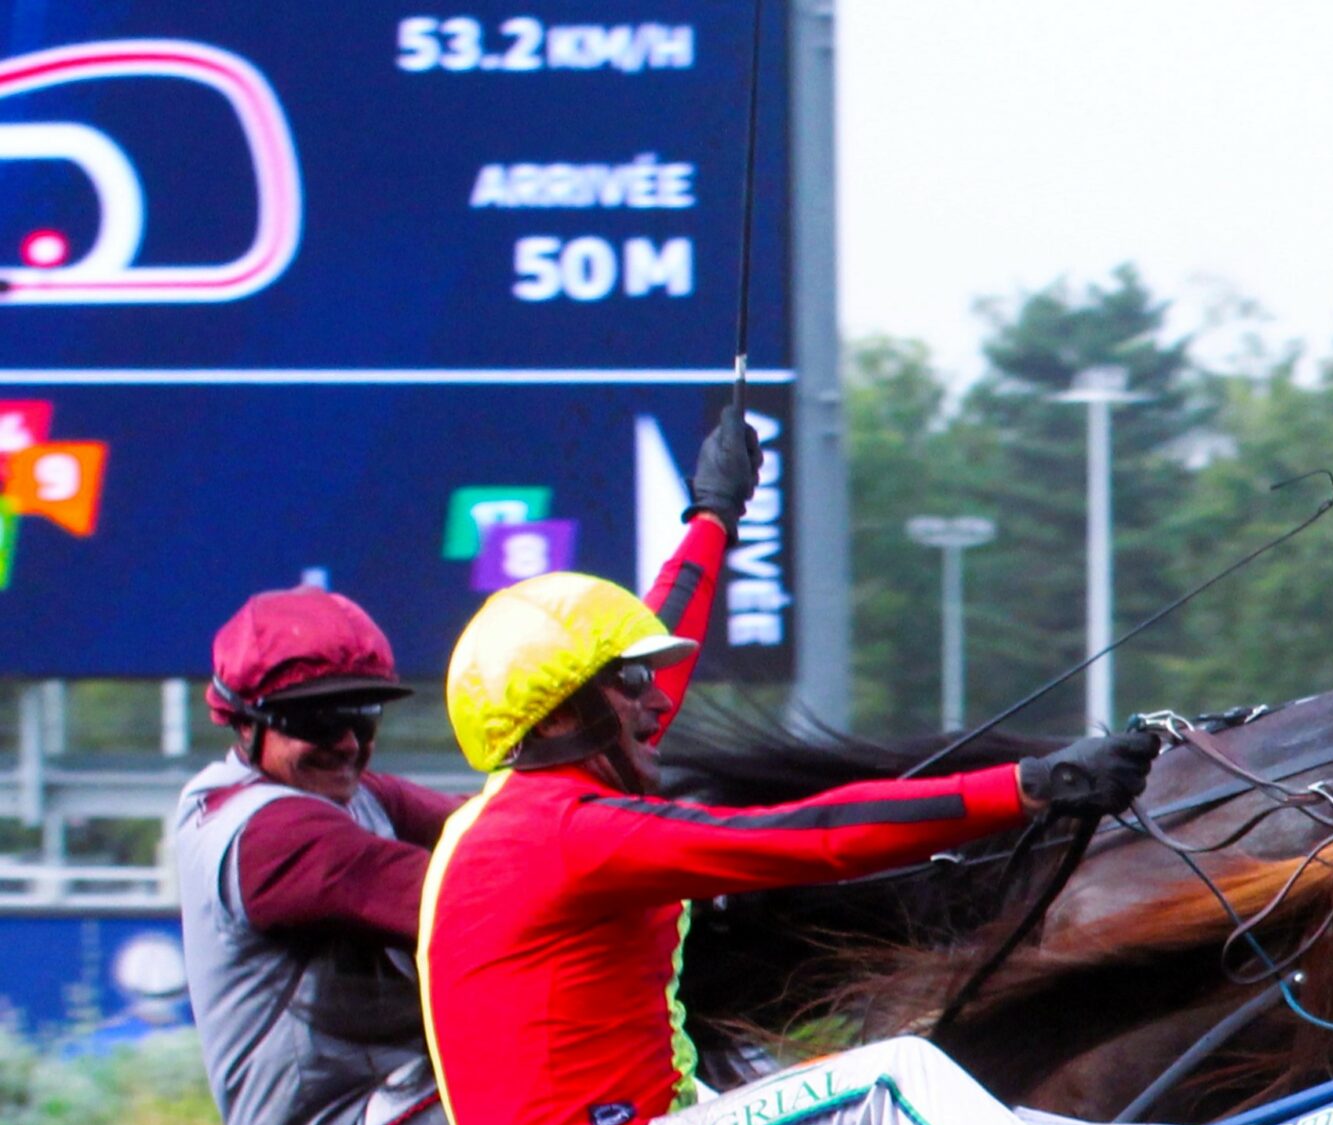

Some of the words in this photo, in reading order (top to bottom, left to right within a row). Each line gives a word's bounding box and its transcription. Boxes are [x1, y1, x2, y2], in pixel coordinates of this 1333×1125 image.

[396, 16, 543, 71] 53.2
[546, 22, 694, 74] KM/H
[469, 151, 697, 208] ARRIVÉE
[512, 235, 616, 301] 50
[623, 236, 693, 297] M
[33, 453, 82, 501] 9
